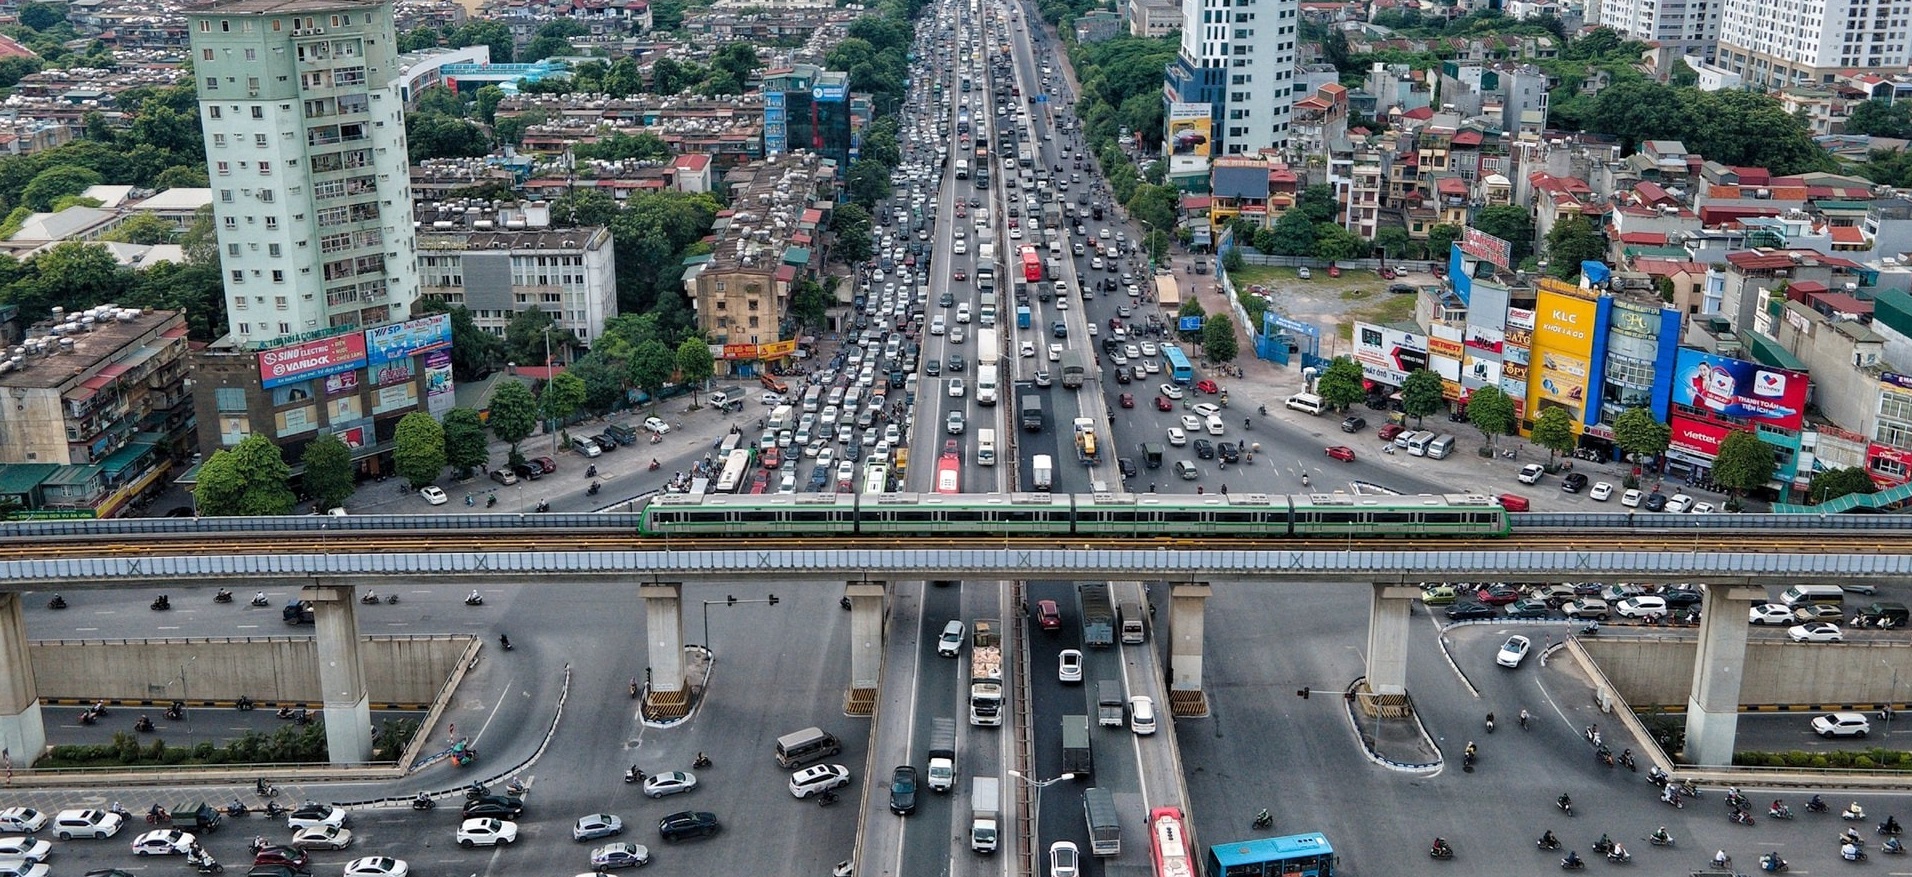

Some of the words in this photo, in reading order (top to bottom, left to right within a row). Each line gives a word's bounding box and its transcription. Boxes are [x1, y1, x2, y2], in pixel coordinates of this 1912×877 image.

[1552, 309, 1577, 324] KLC
[278, 348, 299, 362] SINO
[300, 345, 329, 357] ELECTRIC
[286, 355, 330, 372] VANLOCK
[1502, 365, 1527, 377] TOPY
[1738, 395, 1760, 406] THANH
[1760, 398, 1779, 410] TOÁN
[1742, 402, 1755, 413] TIỆN
[1756, 404, 1768, 414] ÍCH
[1683, 430, 1717, 445] viettel
